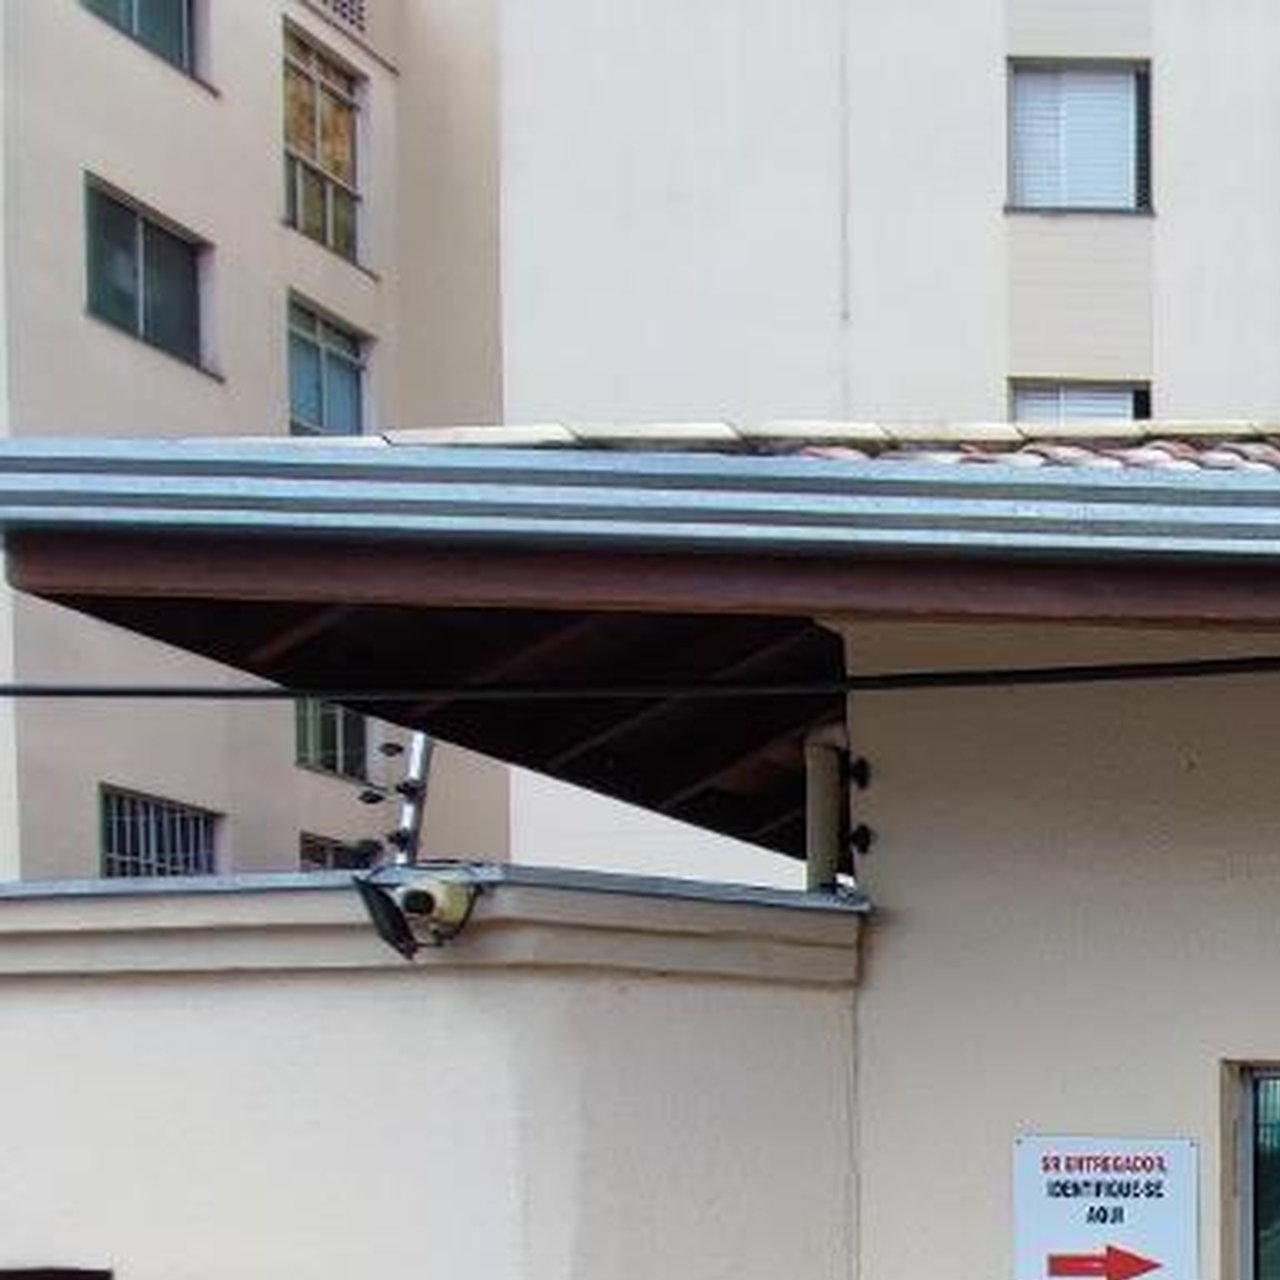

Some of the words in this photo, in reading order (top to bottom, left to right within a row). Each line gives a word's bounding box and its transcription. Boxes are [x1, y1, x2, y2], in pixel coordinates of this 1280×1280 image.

[1042, 1155, 1060, 1172] SR
[1046, 1179, 1164, 1198] IDENTIFIQUE-SE
[1086, 1205, 1124, 1224] AQUI
